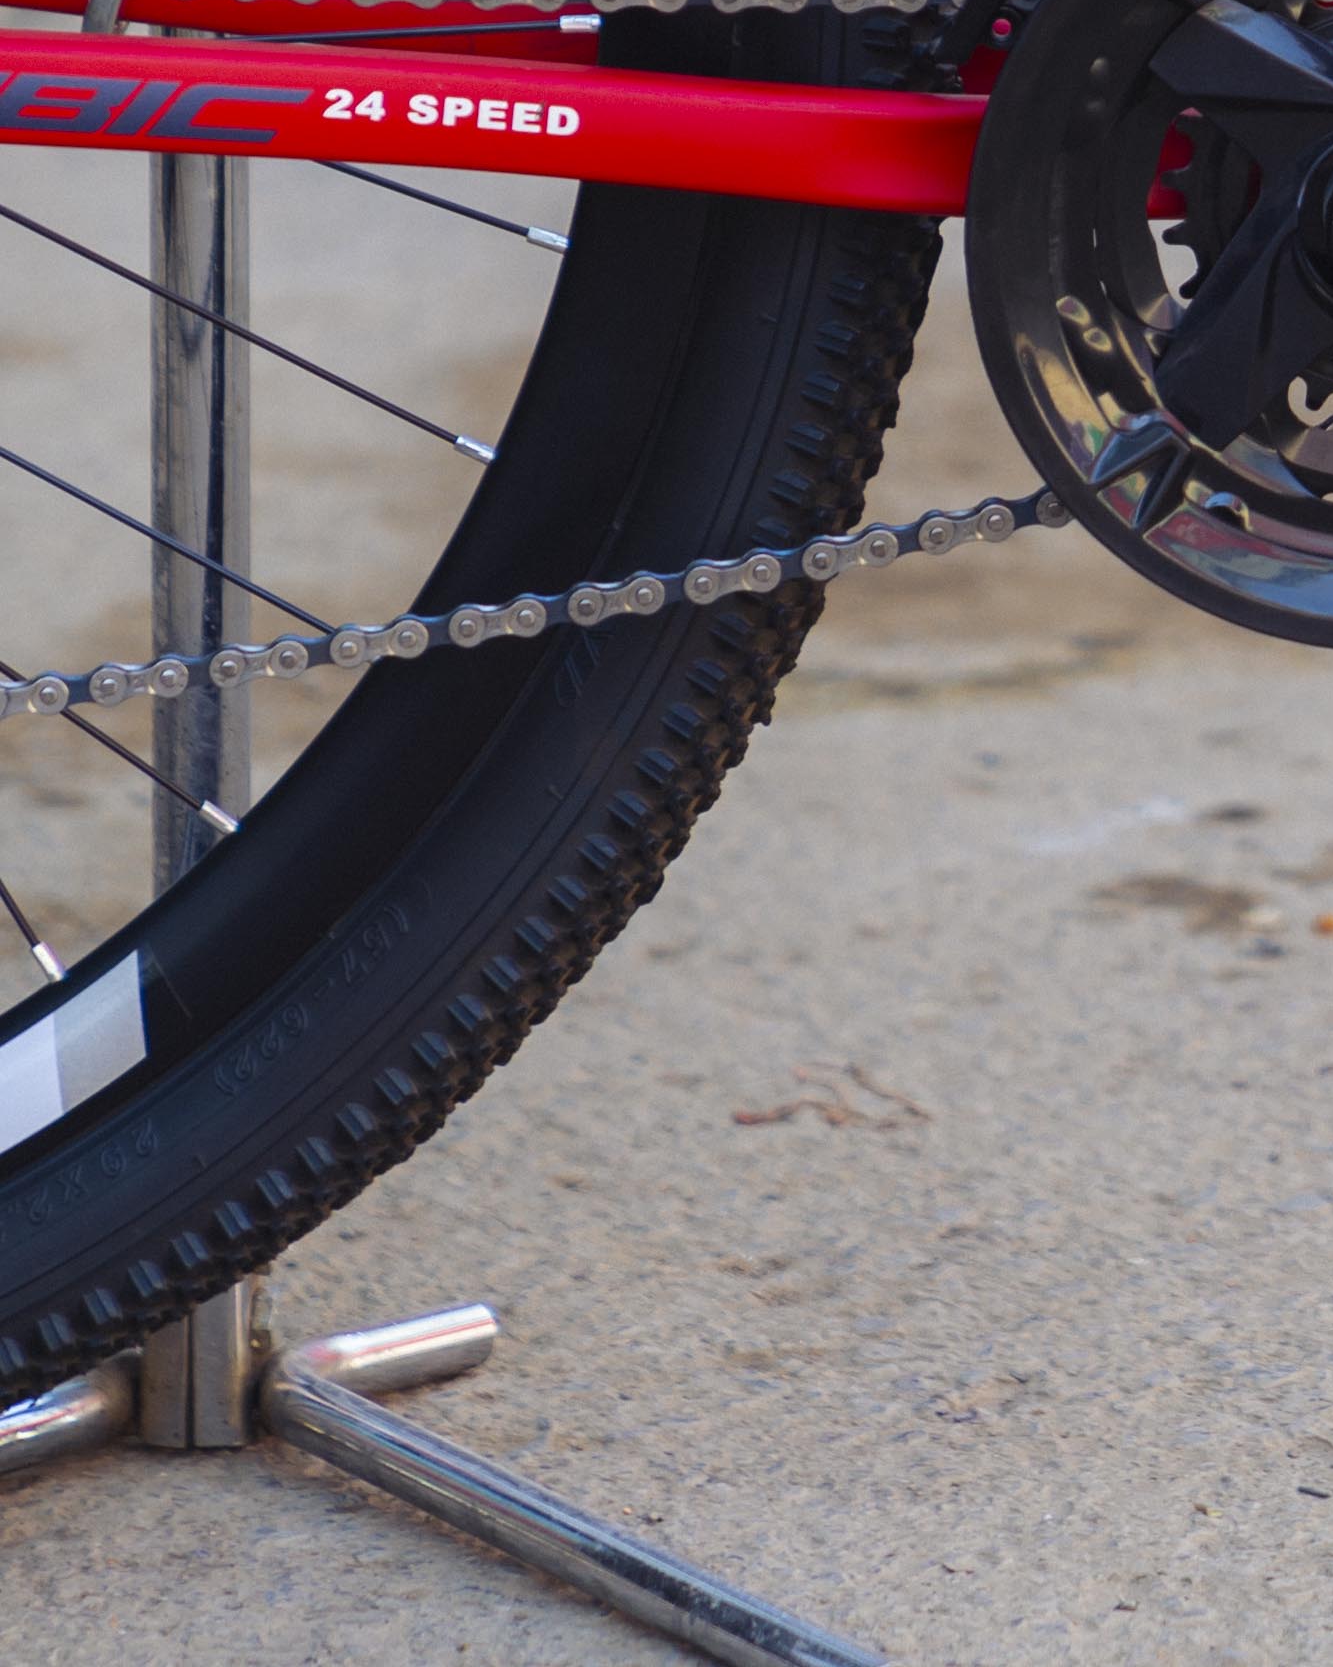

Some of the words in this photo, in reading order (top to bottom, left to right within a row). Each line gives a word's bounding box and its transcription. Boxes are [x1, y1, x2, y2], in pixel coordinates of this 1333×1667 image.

[0, 69, 314, 144] BIC
[322, 87, 387, 122] 24
[406, 92, 582, 137] SPEED
